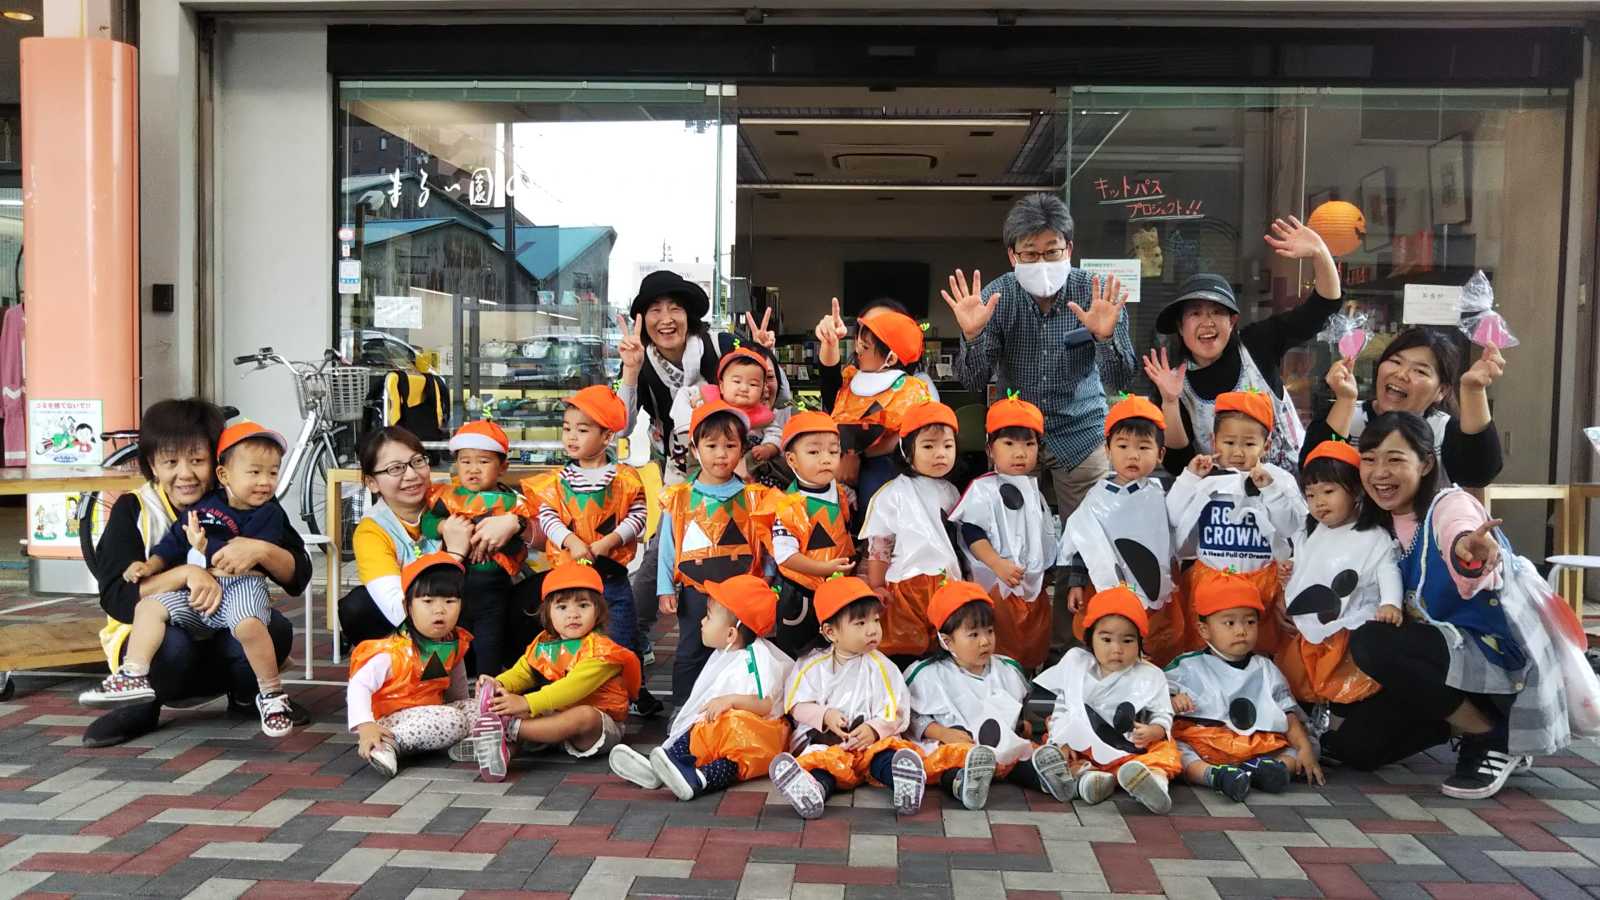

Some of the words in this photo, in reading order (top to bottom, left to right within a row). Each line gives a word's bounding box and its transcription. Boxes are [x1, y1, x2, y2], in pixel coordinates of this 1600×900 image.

[1094, 175, 1163, 199] キットパス
